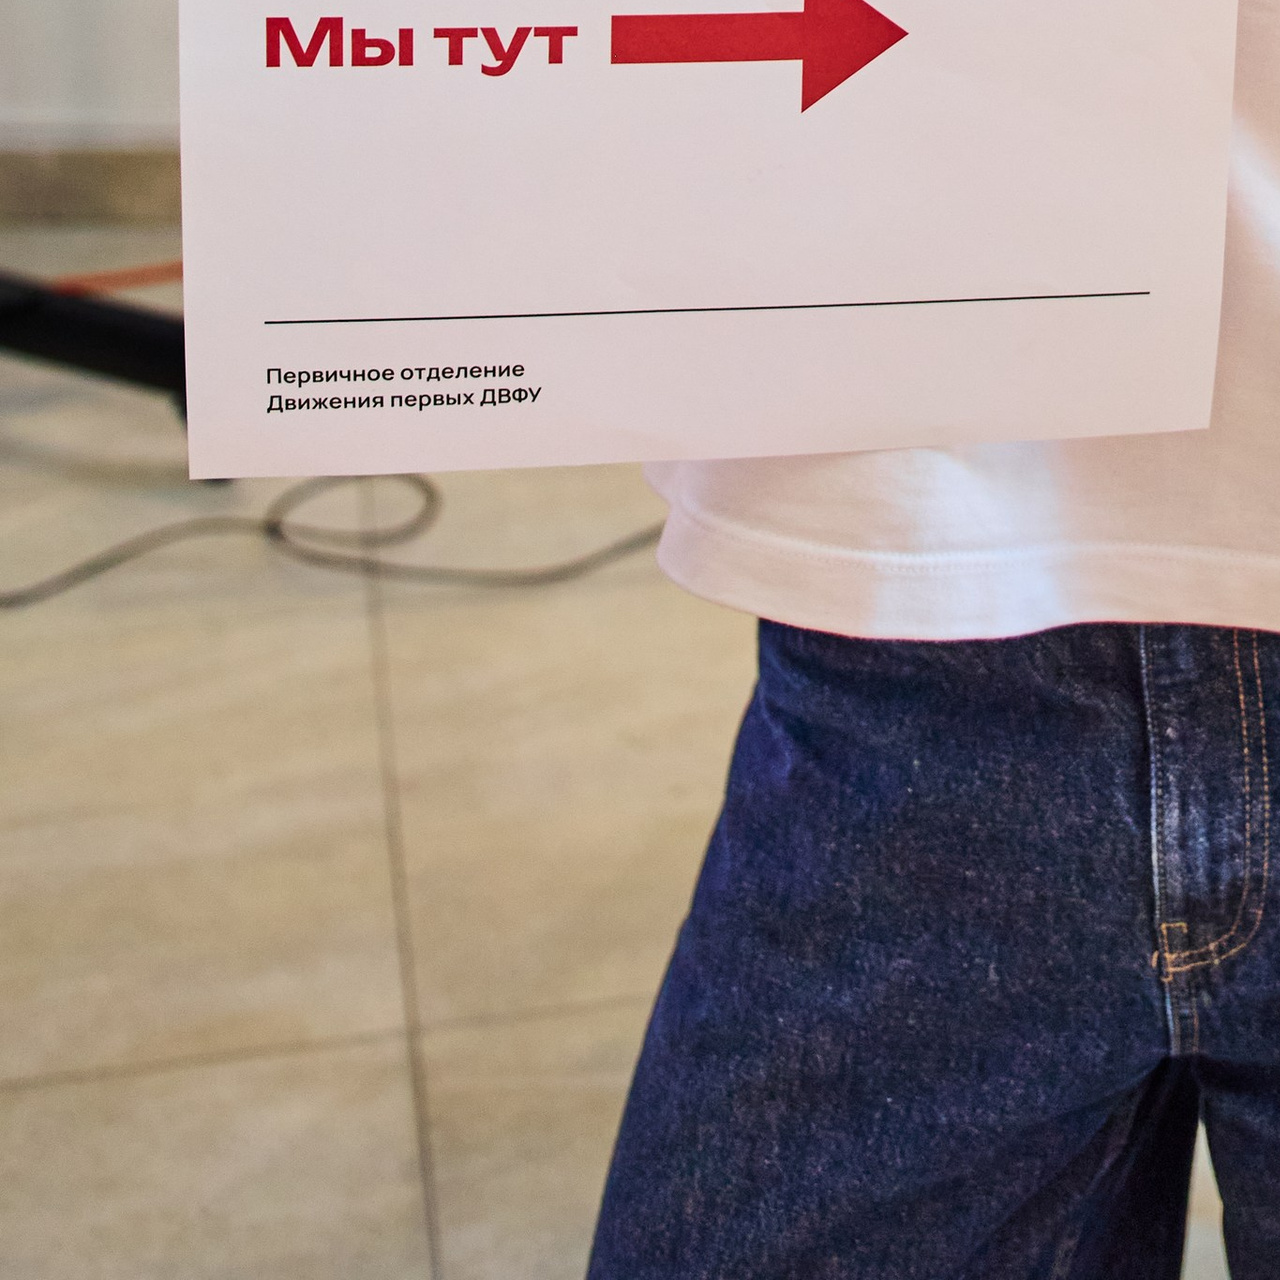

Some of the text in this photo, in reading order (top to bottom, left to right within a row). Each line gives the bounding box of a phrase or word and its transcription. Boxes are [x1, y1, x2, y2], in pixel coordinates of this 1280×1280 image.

[264, 16, 579, 77] Мы тут
[265, 363, 526, 389] Первичное отделение
[265, 385, 543, 415] Движения первых ДВФУ
